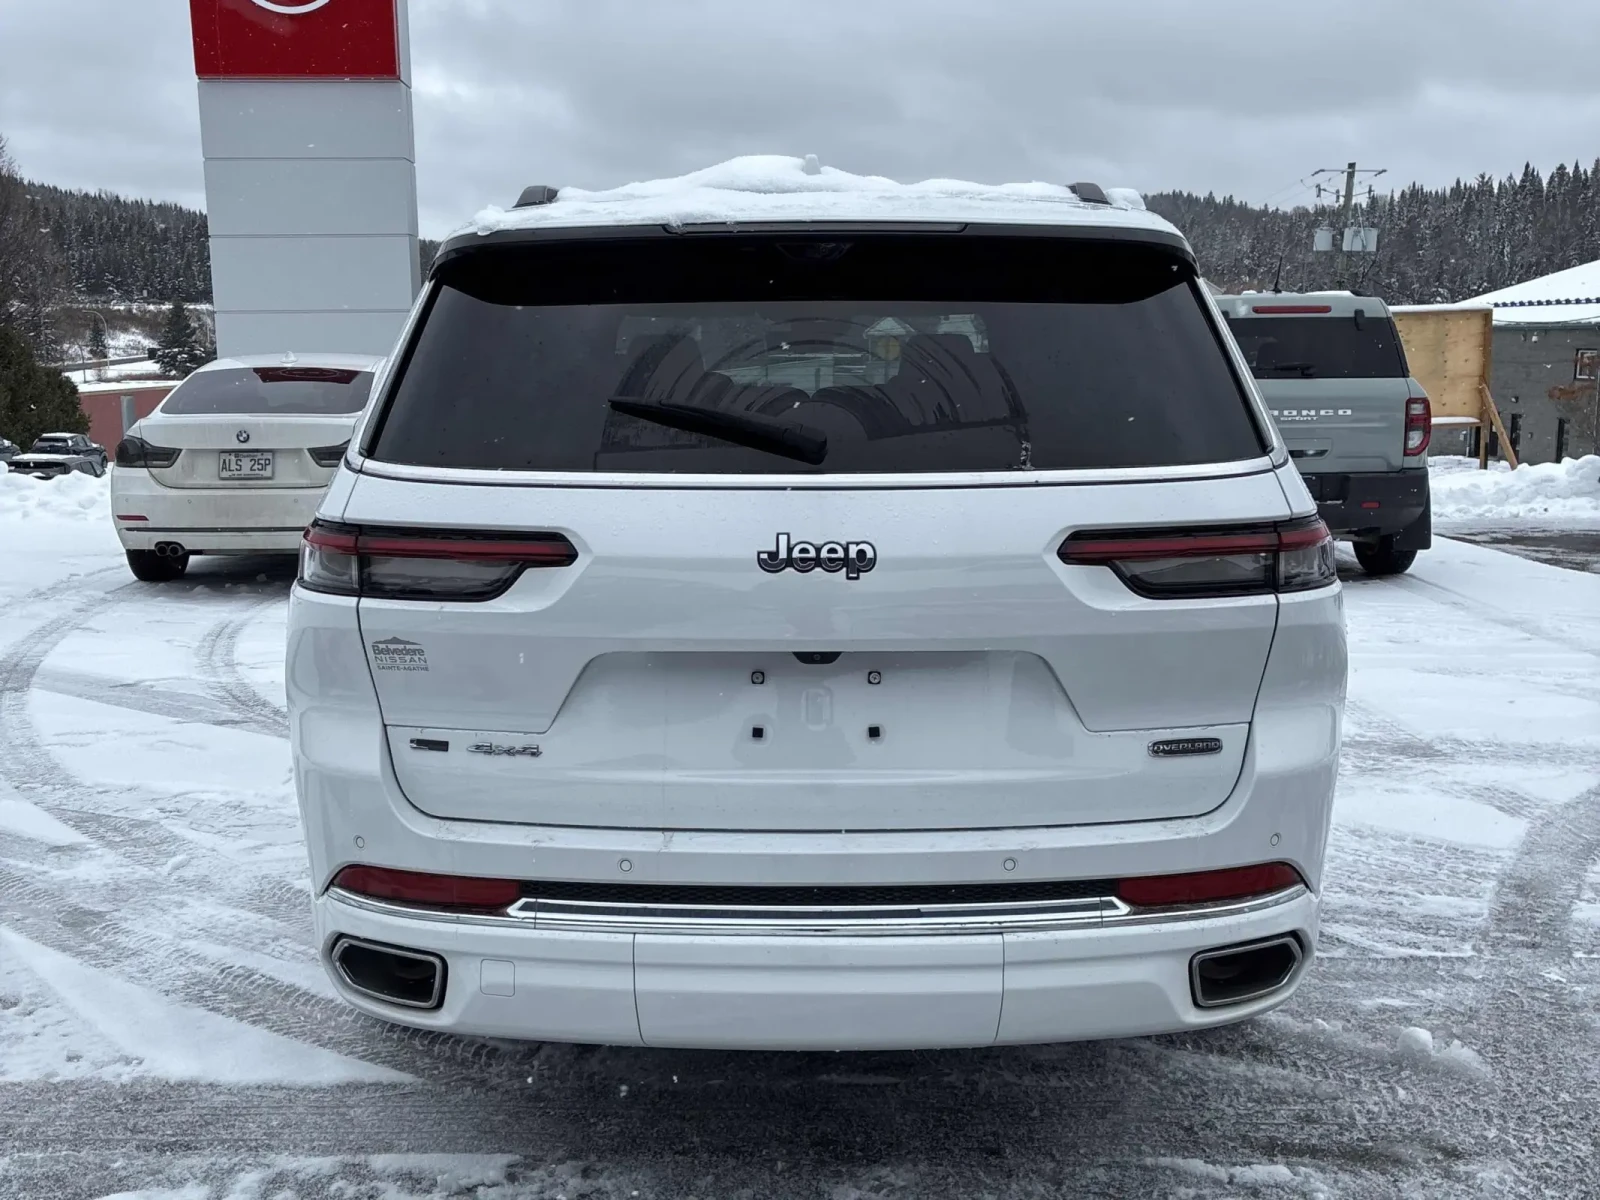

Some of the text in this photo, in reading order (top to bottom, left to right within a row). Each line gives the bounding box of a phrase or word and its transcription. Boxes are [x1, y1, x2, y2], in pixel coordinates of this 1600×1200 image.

[221, 458, 271, 472] ALS 25P
[757, 532, 877, 580] Jeep
[372, 644, 425, 656] Belvedere
[374, 656, 427, 664] NISSAN
[1153, 741, 1220, 752] OVERLAND
